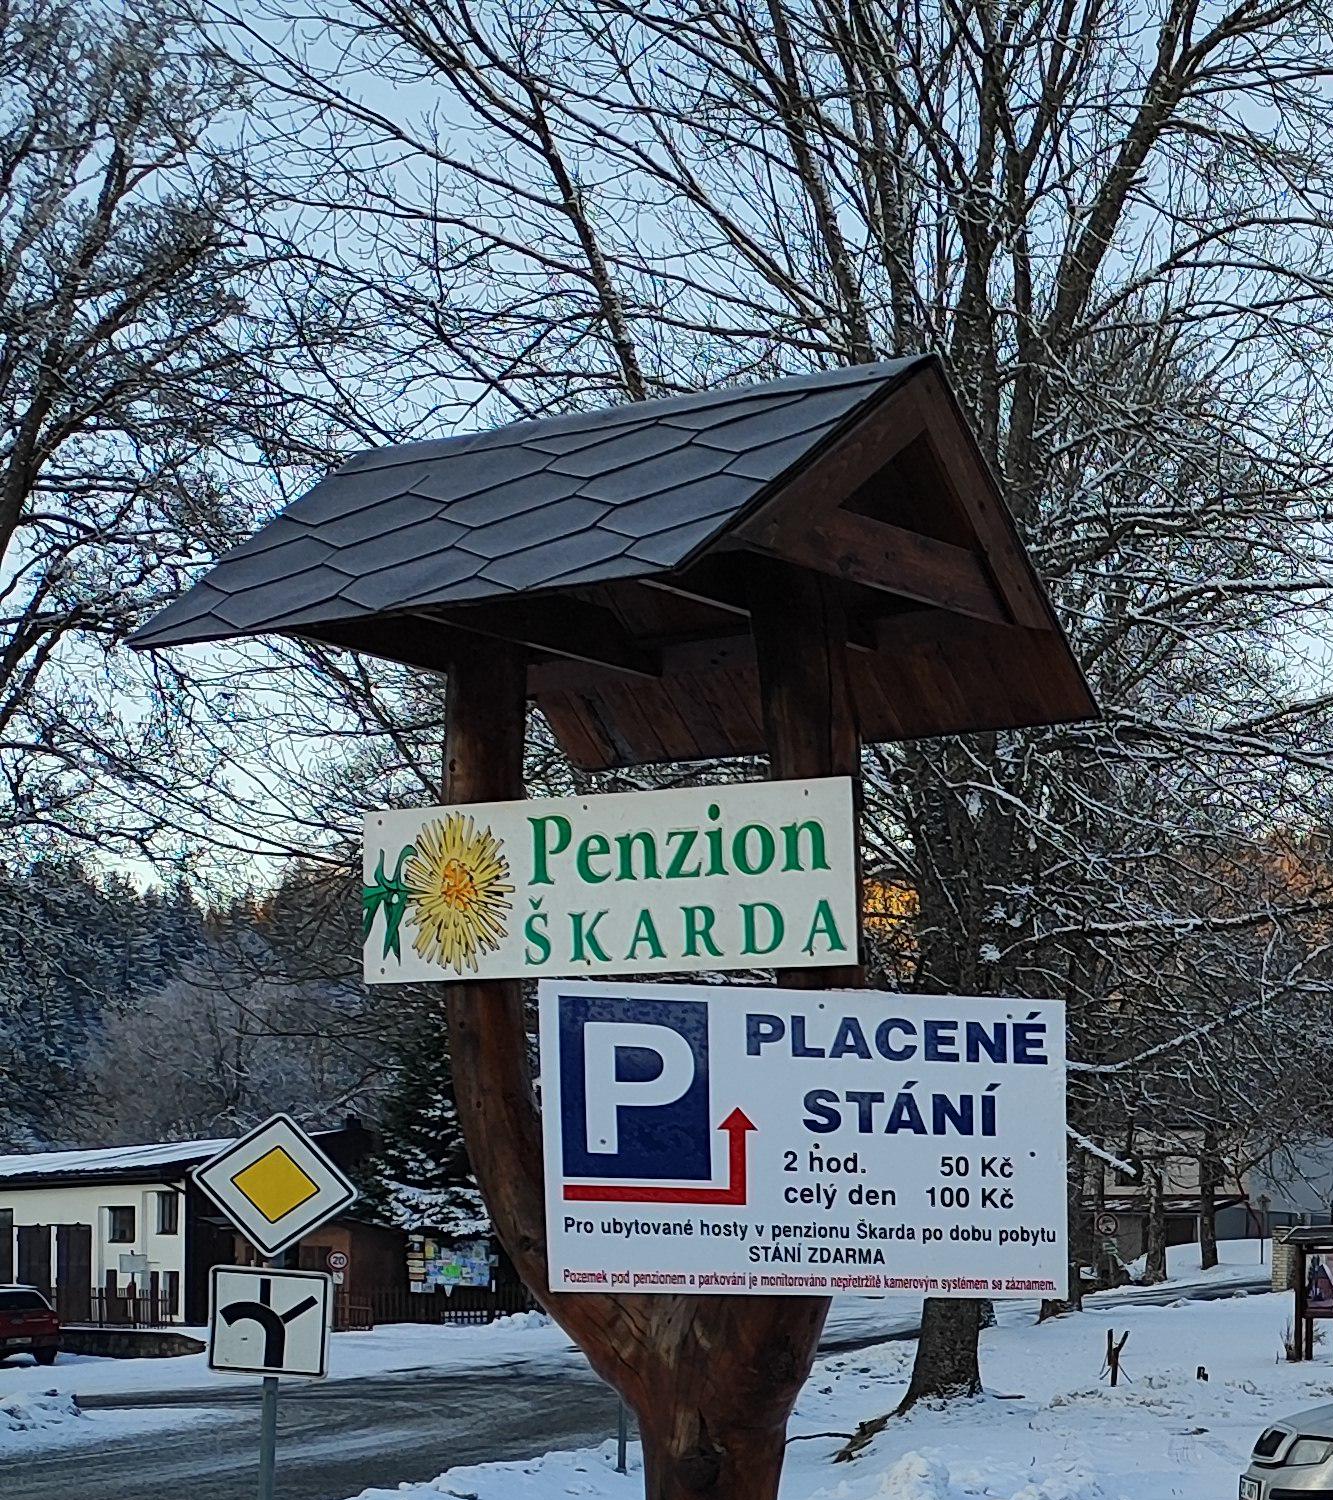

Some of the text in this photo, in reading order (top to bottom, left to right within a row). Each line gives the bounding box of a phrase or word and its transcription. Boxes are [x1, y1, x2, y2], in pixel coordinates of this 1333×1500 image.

[527, 803, 831, 885] Penzion
[524, 895, 847, 965] ŠKARDA
[746, 1011, 1048, 1065] PLACENÉ
[584, 1022, 695, 1154] P
[802, 1080, 1001, 1136] STÁNÍ
[784, 1151, 1014, 1178] 2 hod. 50 Kč
[784, 1183, 1014, 1209] celý den 100 Kč
[564, 1217, 1056, 1246] Pro ubytované hosty v penzionu Škarda po dobu pobytu
[332, 1255, 345, 1266] 20
[749, 1242, 885, 1264] STÁNÍ ZDARMA
[564, 1269, 608, 1284] Pozemek
[611, 1270, 630, 1287] pod
[633, 1270, 686, 1287] penzionem
[689, 1275, 695, 1284] a
[749, 1272, 758, 1289] je
[884, 1275, 938, 1292] kamerovým
[942, 1276, 988, 1293] systémem
